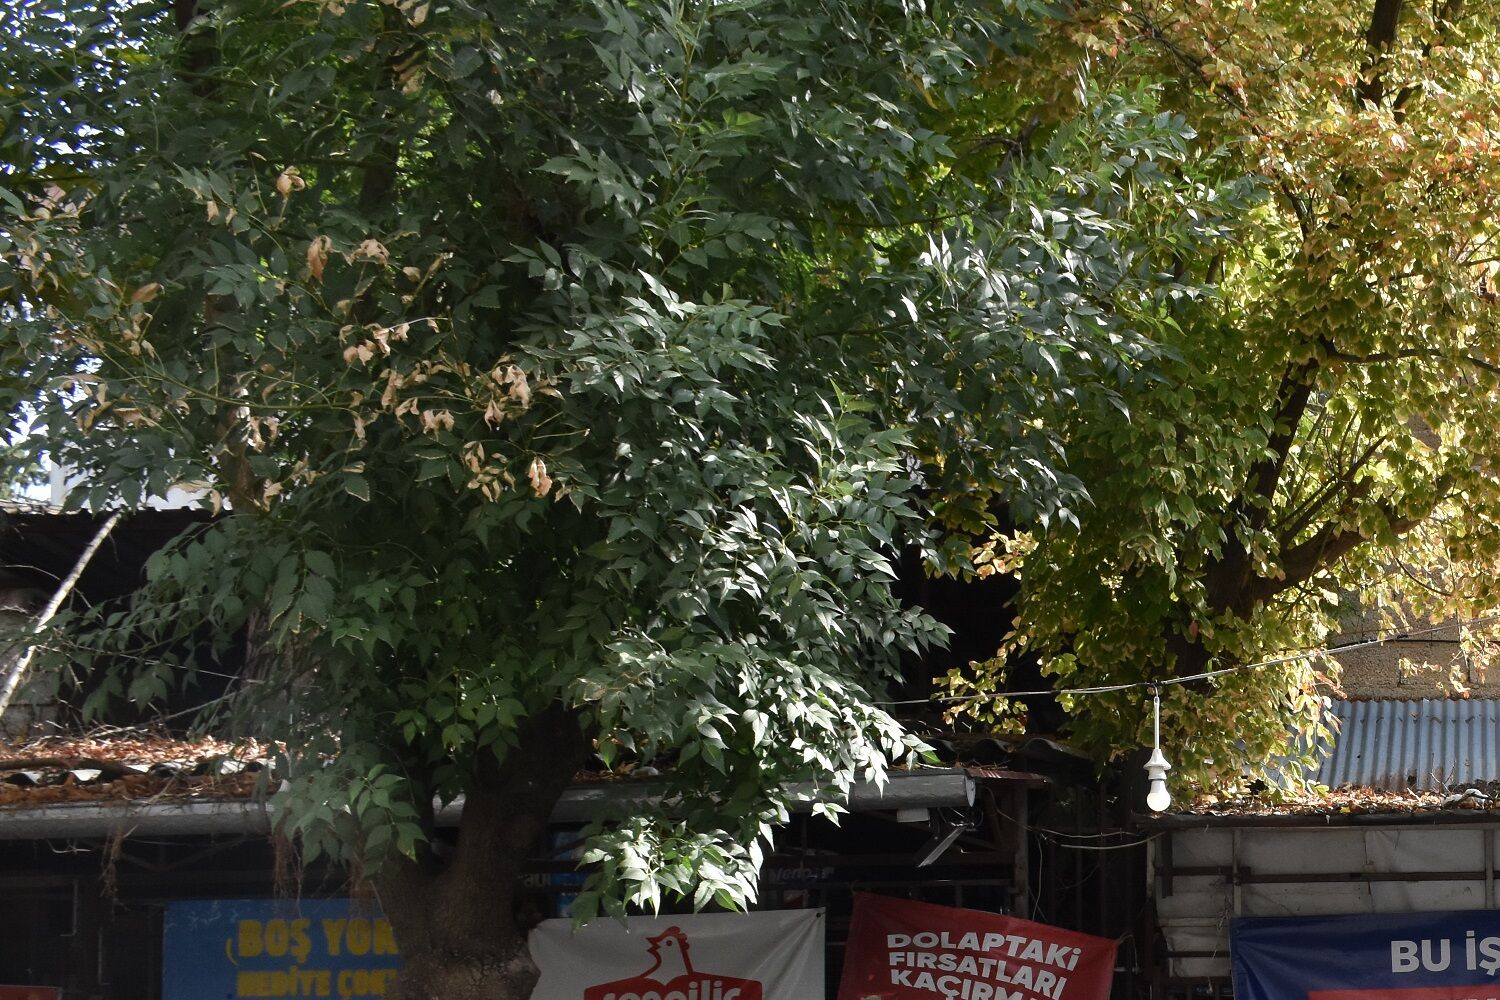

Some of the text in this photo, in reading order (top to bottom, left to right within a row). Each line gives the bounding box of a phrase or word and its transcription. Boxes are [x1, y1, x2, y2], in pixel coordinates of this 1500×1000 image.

[237, 918, 311, 964] BOŞ
[887, 931, 1082, 971] DOLAPTAKİ
[1391, 939, 1450, 973] BU
